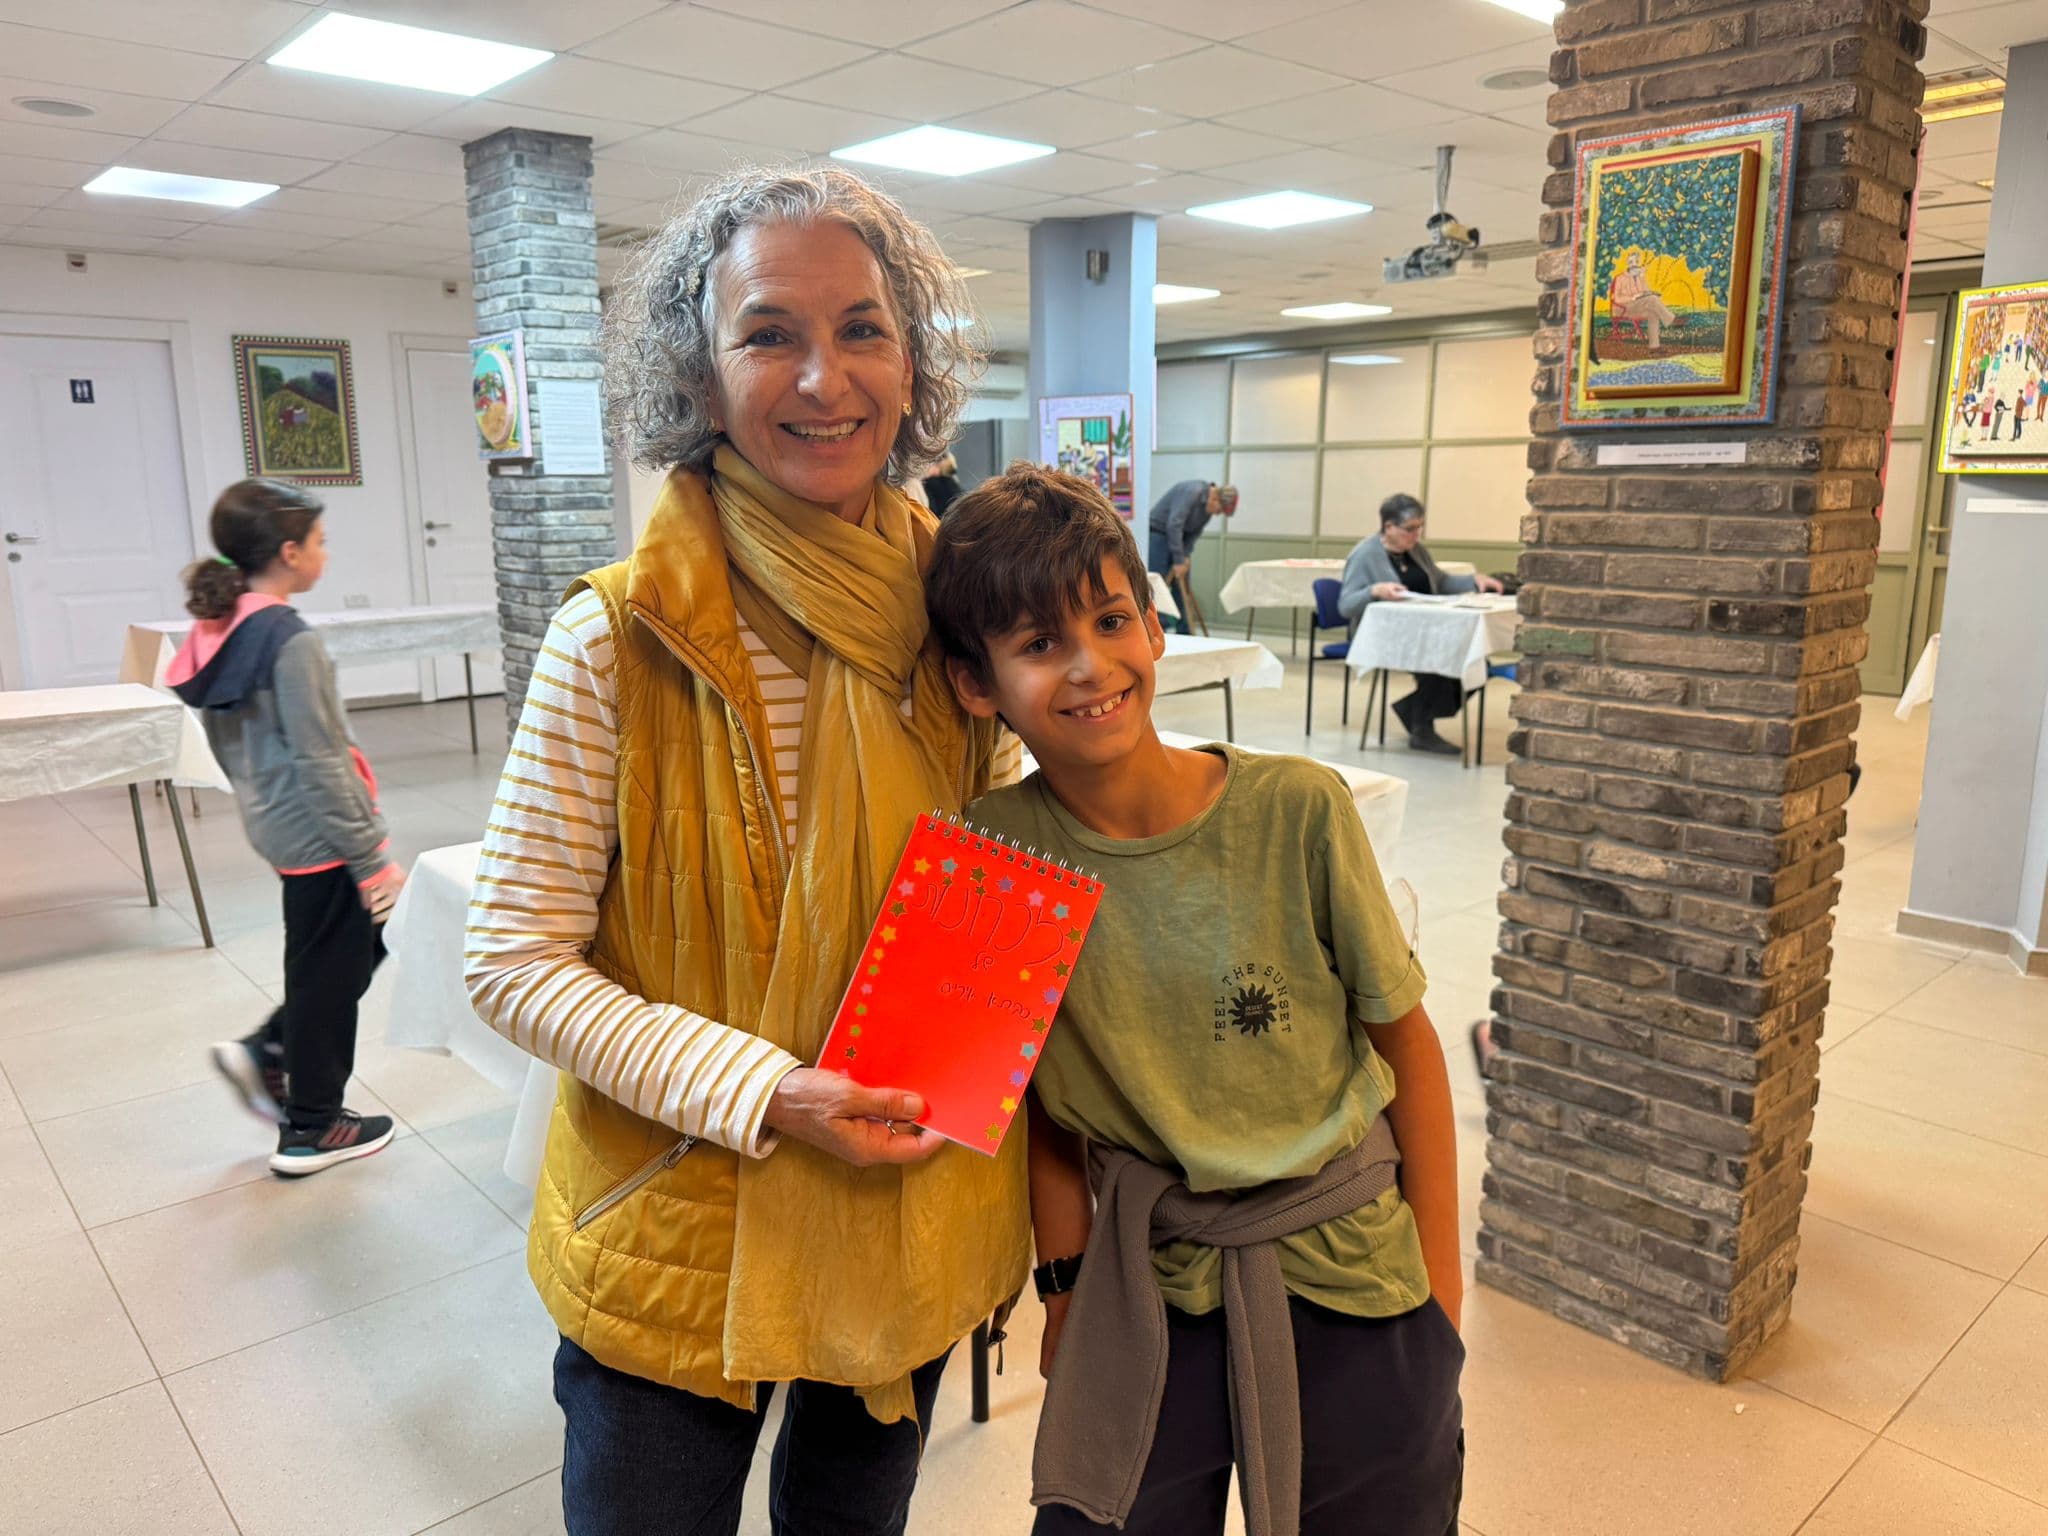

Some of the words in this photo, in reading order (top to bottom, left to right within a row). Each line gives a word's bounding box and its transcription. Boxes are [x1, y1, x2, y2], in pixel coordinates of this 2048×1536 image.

[971, 951, 994, 971] של
[1214, 996, 1226, 1042] FEEL
[1222, 963, 1256, 986] THE
[1263, 965, 1292, 1033] SUNSET
